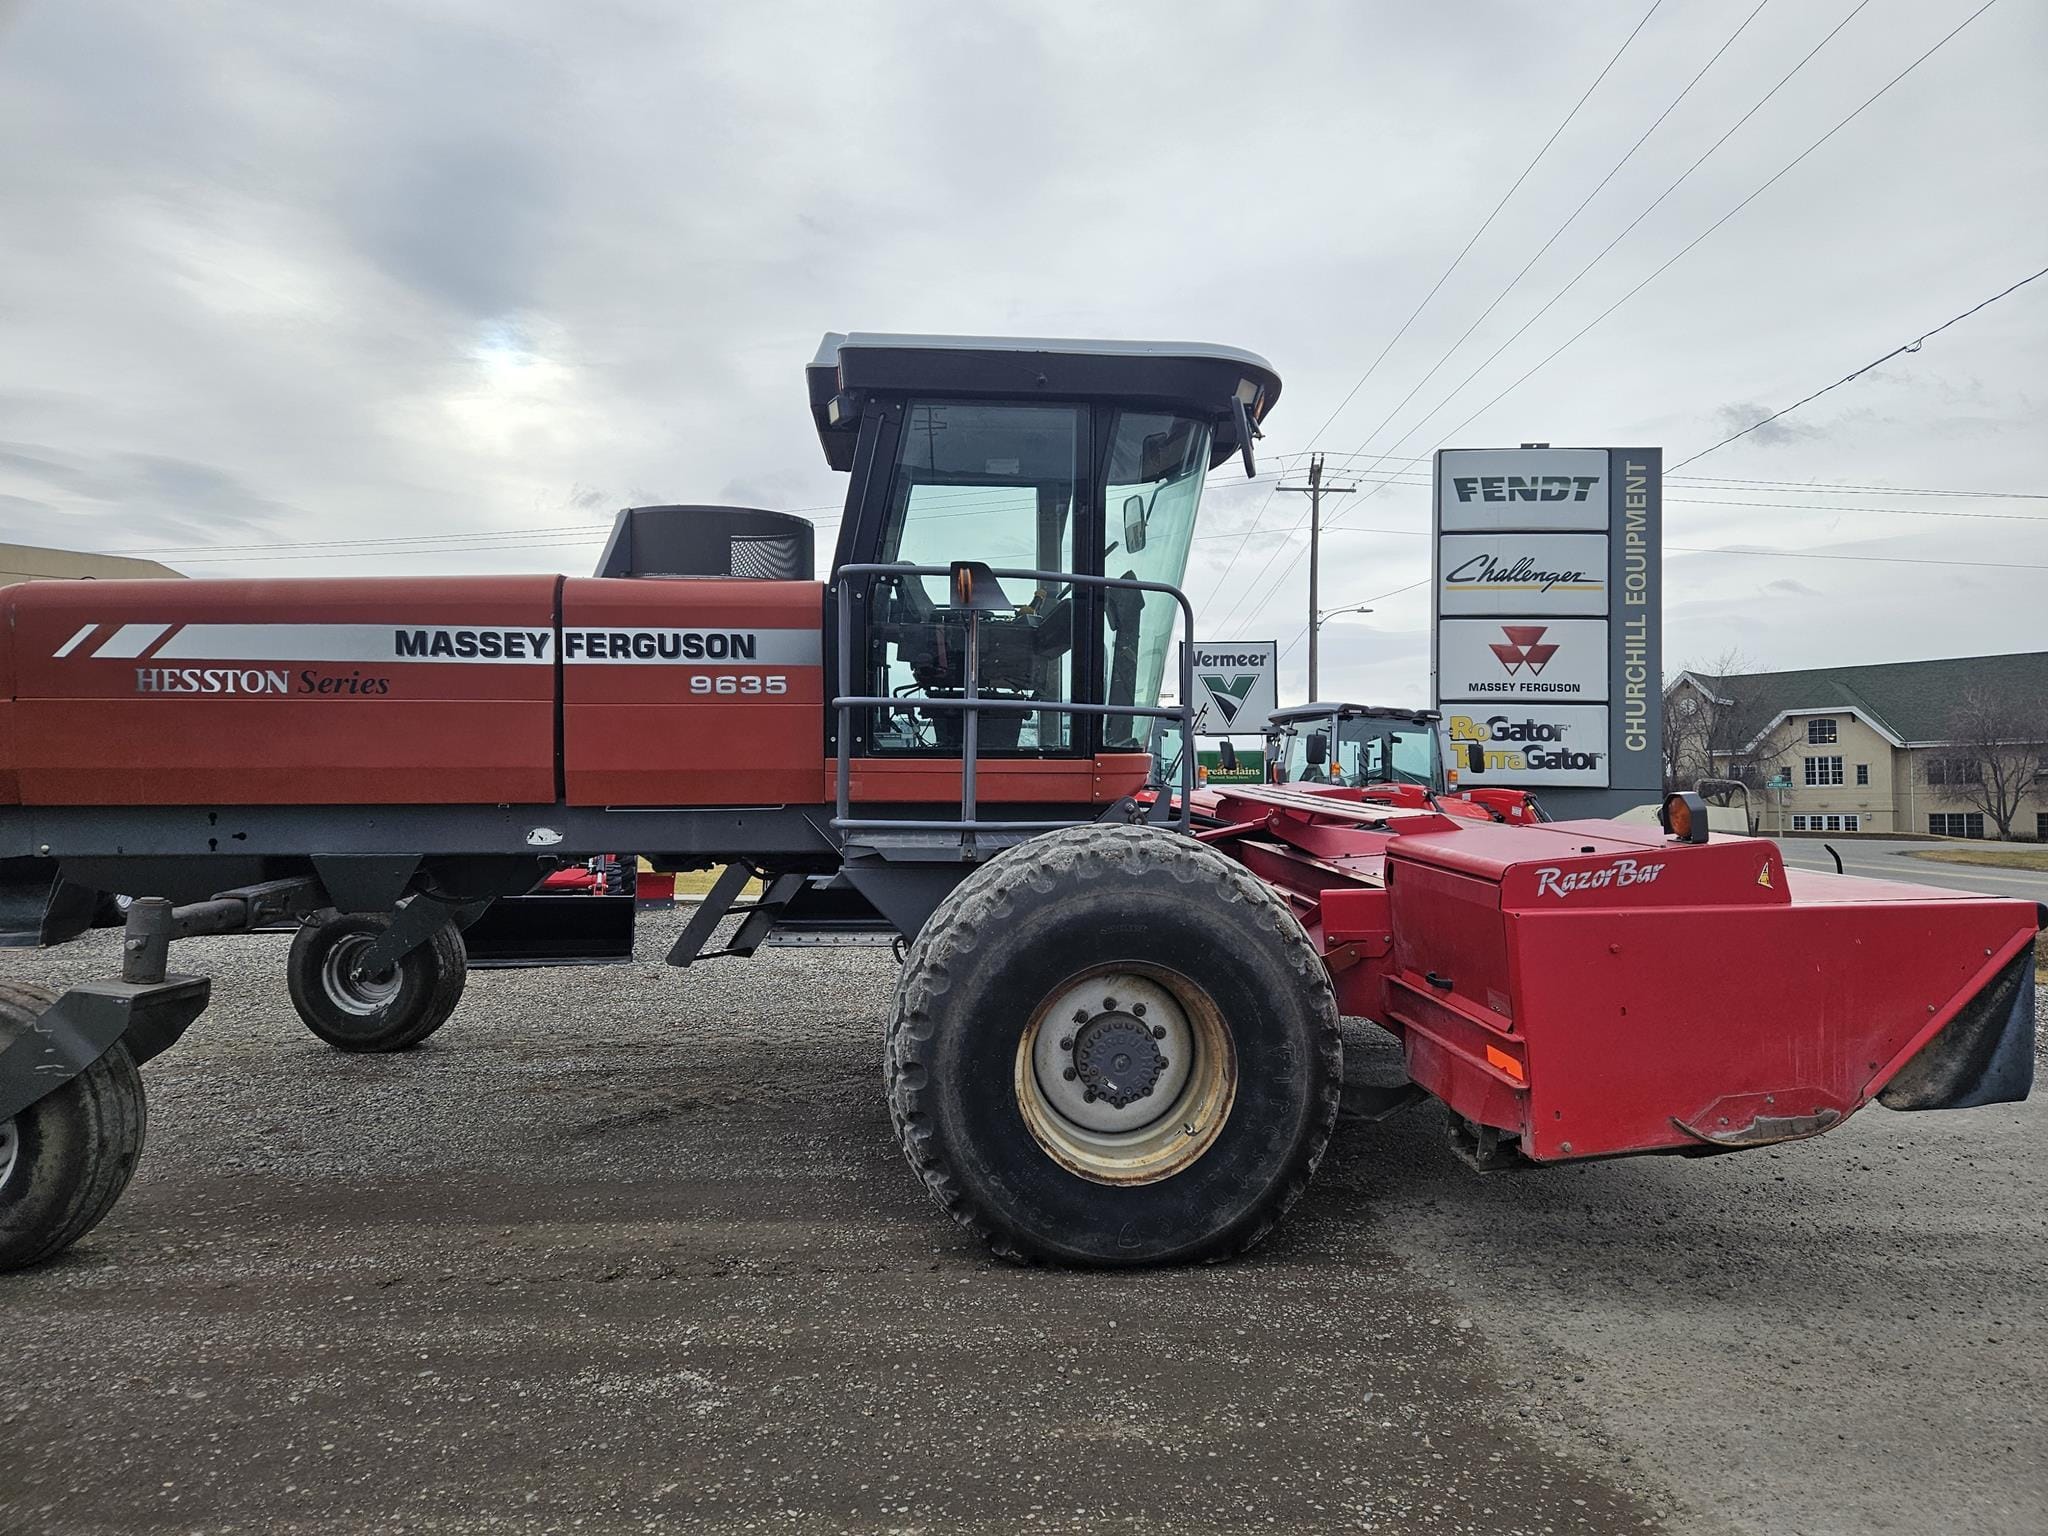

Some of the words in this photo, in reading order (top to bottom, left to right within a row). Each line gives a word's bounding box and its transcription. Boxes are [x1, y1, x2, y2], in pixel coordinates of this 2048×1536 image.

[1453, 476, 1600, 502] FENDT
[1625, 460, 1647, 605] EQUIPMENT
[1446, 554, 1604, 593] Challenger
[395, 630, 551, 658] MASSEY
[564, 633, 757, 660] FERGUSON
[1192, 651, 1267, 667] Vermeer
[135, 668, 289, 693] HESSTON
[297, 670, 390, 694] Series
[689, 675, 788, 694] 9635
[1468, 682, 1516, 692] MASSEY
[1520, 683, 1580, 693] FERGUSON
[1625, 614, 1646, 751] CHURCHILL
[1450, 715, 1568, 742] RoGator
[1450, 744, 1603, 770] TrraGator
